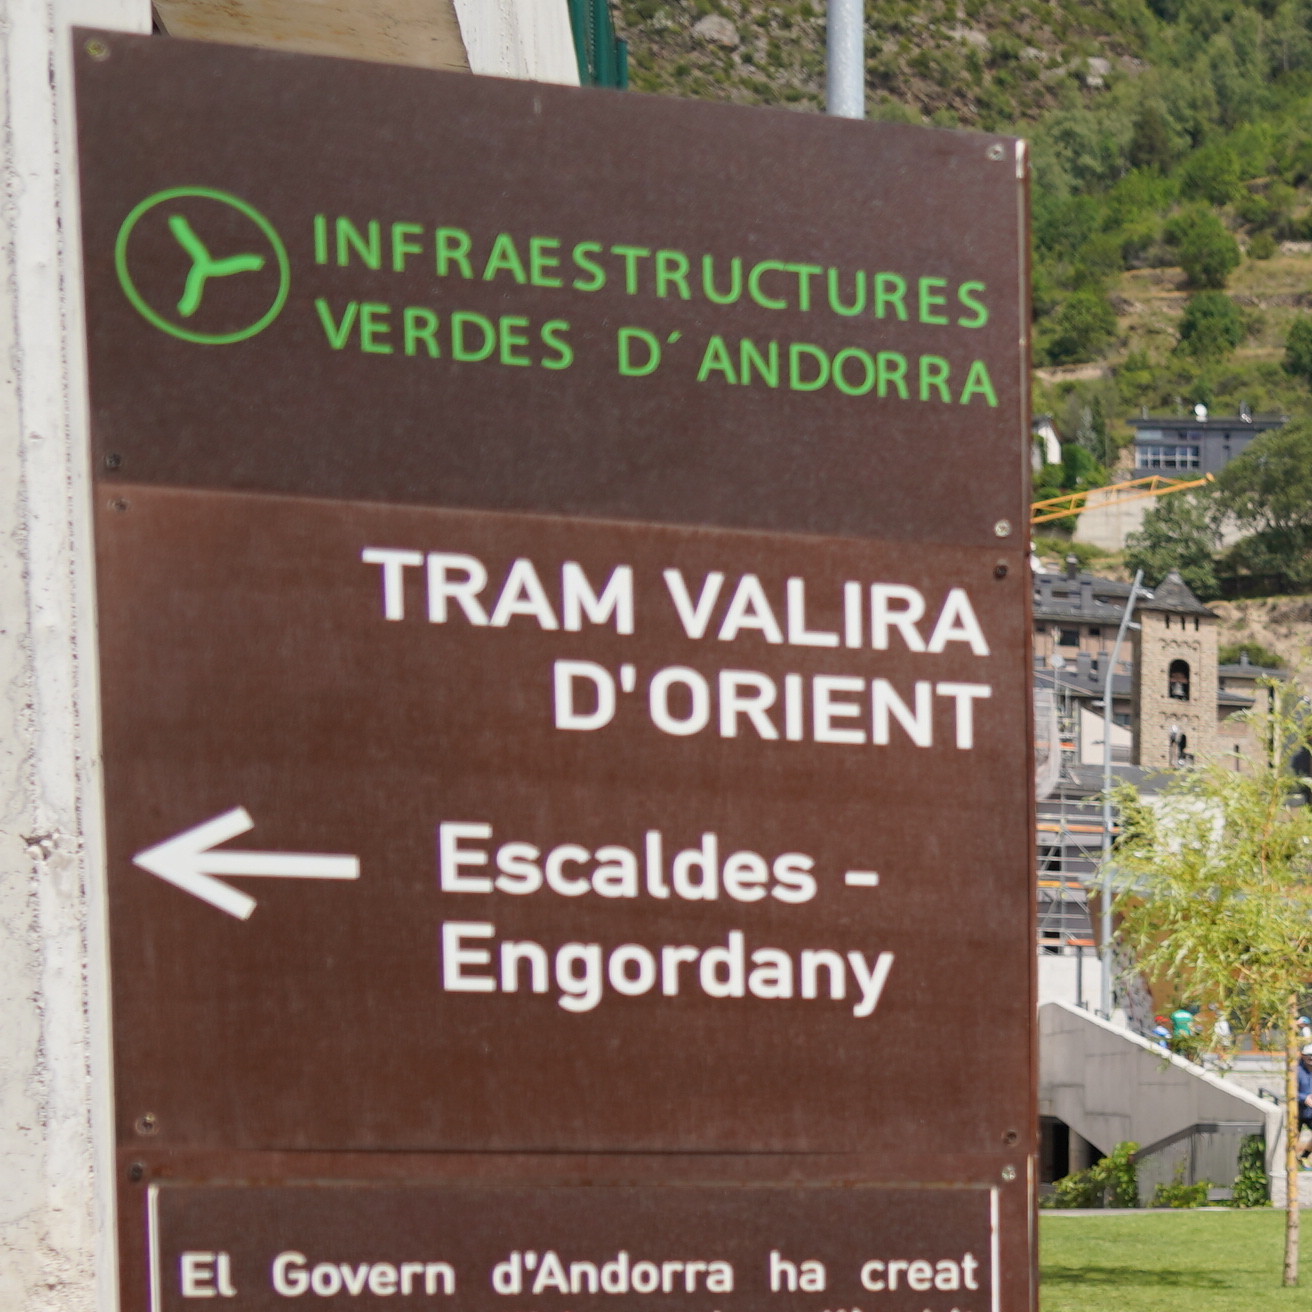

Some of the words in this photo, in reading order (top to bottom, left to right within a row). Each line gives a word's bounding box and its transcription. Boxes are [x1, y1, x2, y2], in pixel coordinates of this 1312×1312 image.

[315, 214, 989, 329] INFRAESTRUCTURES
[316, 300, 572, 369] VERDES
[363, 549, 633, 634] TRAM
[664, 570, 989, 655] VALIRA
[555, 661, 991, 749] D'ORIENT
[440, 823, 816, 903] Escaldes
[443, 923, 893, 1017] Engordany
[182, 1253, 235, 1296] El
[273, 1253, 454, 1296] Govern
[493, 1252, 732, 1294] d'Andorra
[771, 1252, 825, 1291] ha
[861, 1254, 977, 1290] creat
